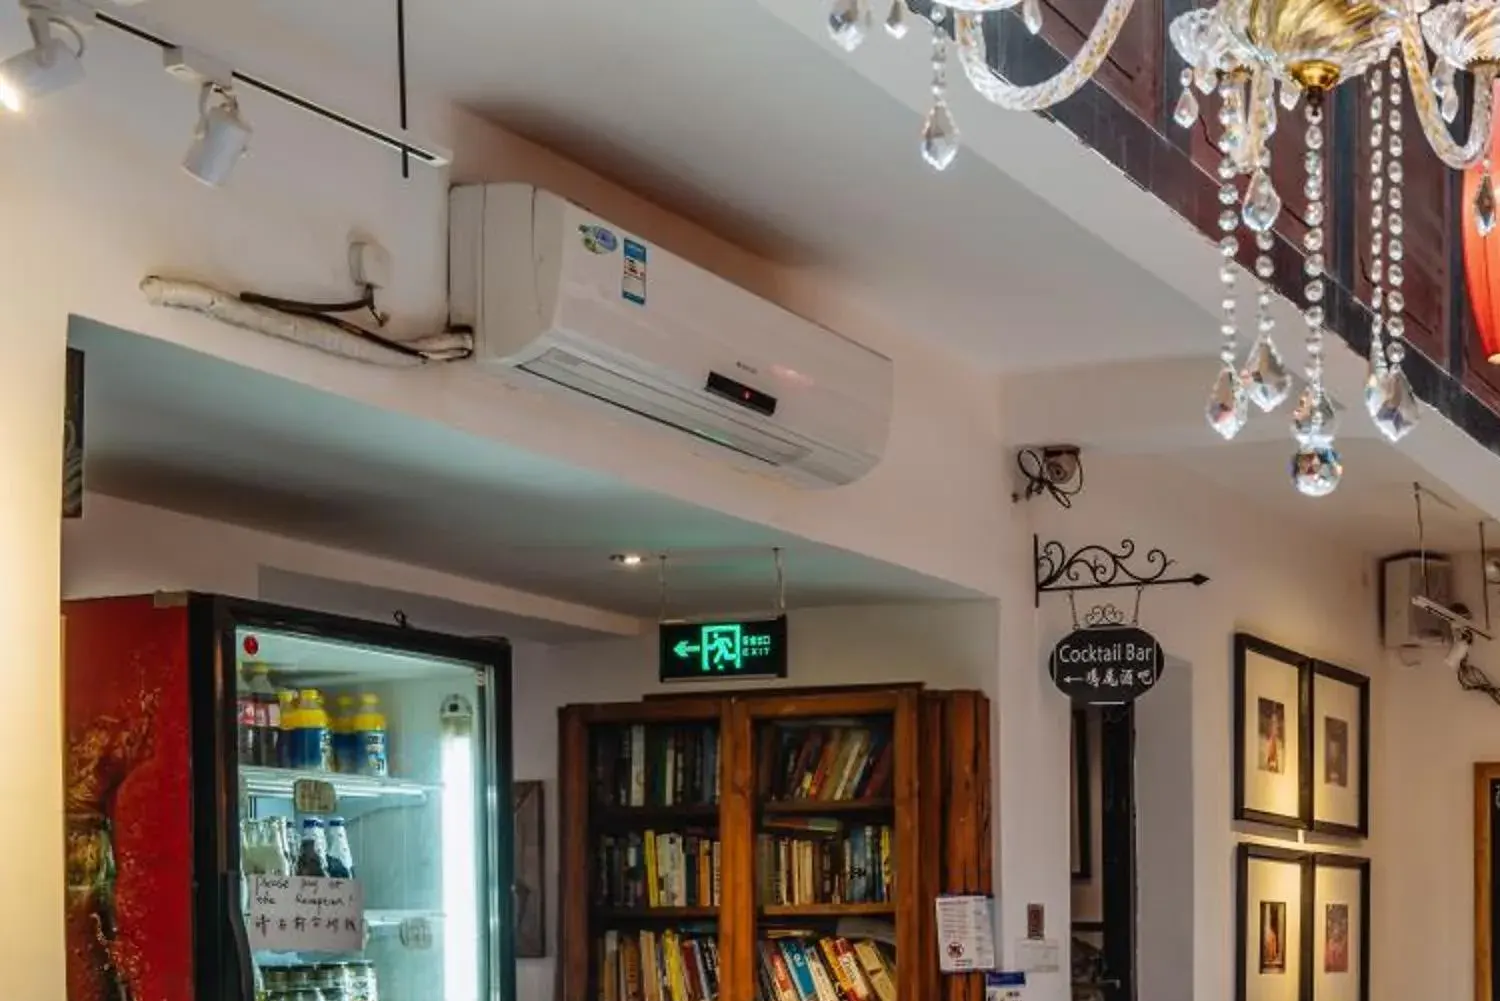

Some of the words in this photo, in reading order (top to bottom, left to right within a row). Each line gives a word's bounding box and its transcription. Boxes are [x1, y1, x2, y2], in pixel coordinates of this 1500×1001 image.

[742, 648, 770, 656] EXIT
[1060, 642, 1121, 662] Cocktail
[1126, 643, 1152, 662] Bar
